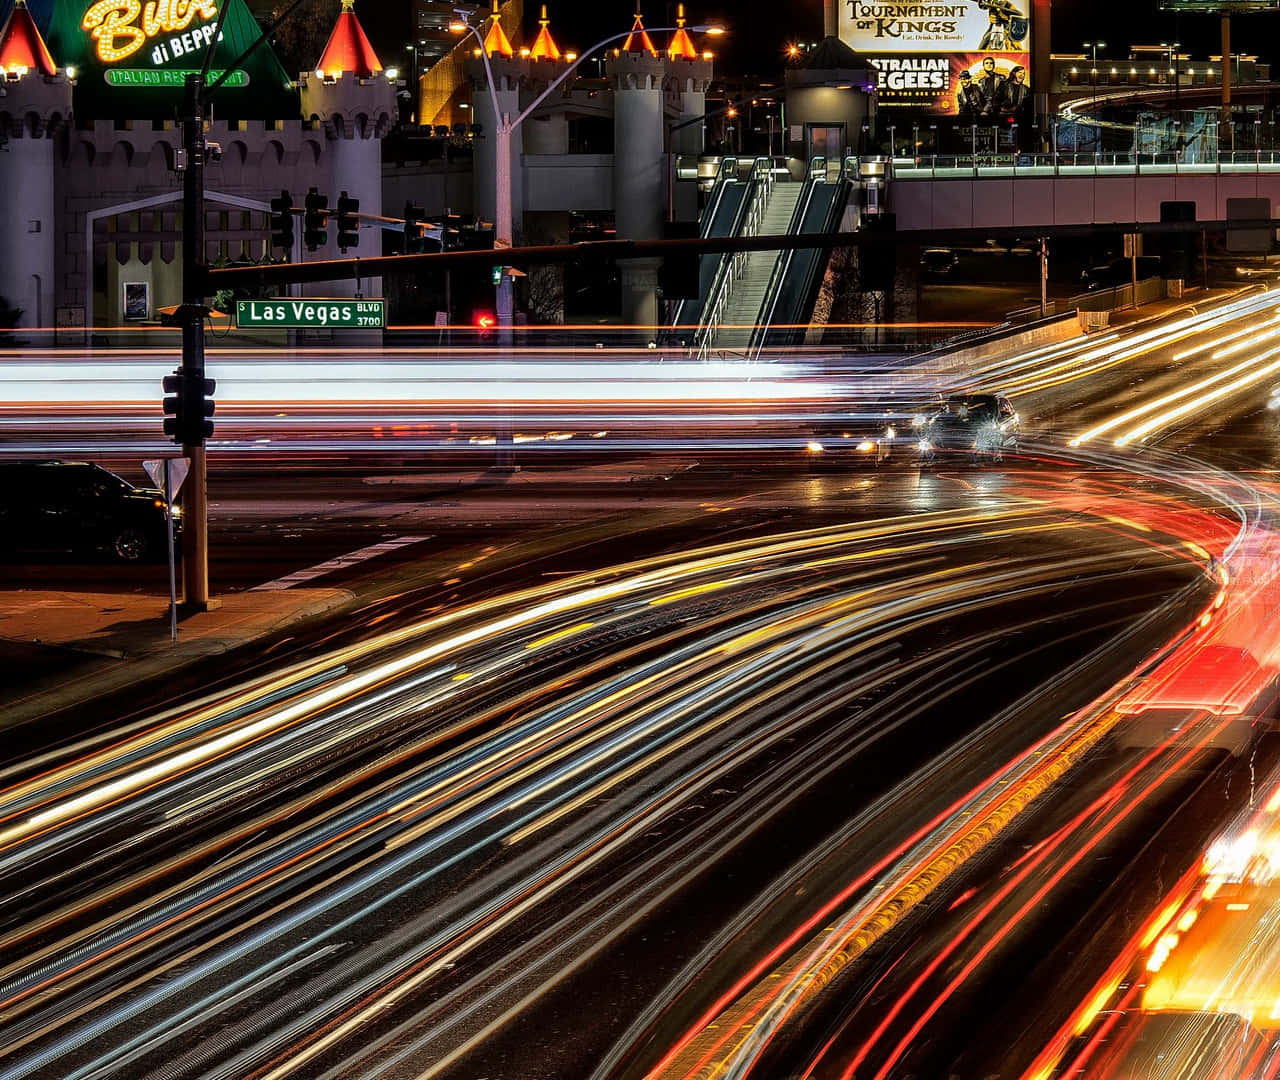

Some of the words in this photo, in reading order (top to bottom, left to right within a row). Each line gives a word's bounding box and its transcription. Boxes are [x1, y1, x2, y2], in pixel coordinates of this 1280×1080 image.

[847, 0, 968, 19] TOURNAMENT
[874, 19, 957, 38] KINGS
[152, 44, 169, 65] di
[867, 59, 949, 71] STRALIAN
[112, 71, 160, 83] ITALIAN
[888, 72, 943, 89] GEES
[239, 303, 245, 311] S
[251, 302, 286, 320] Las
[292, 302, 352, 325] Vegas
[356, 303, 380, 312] BLVD
[357, 317, 380, 326] 3700
